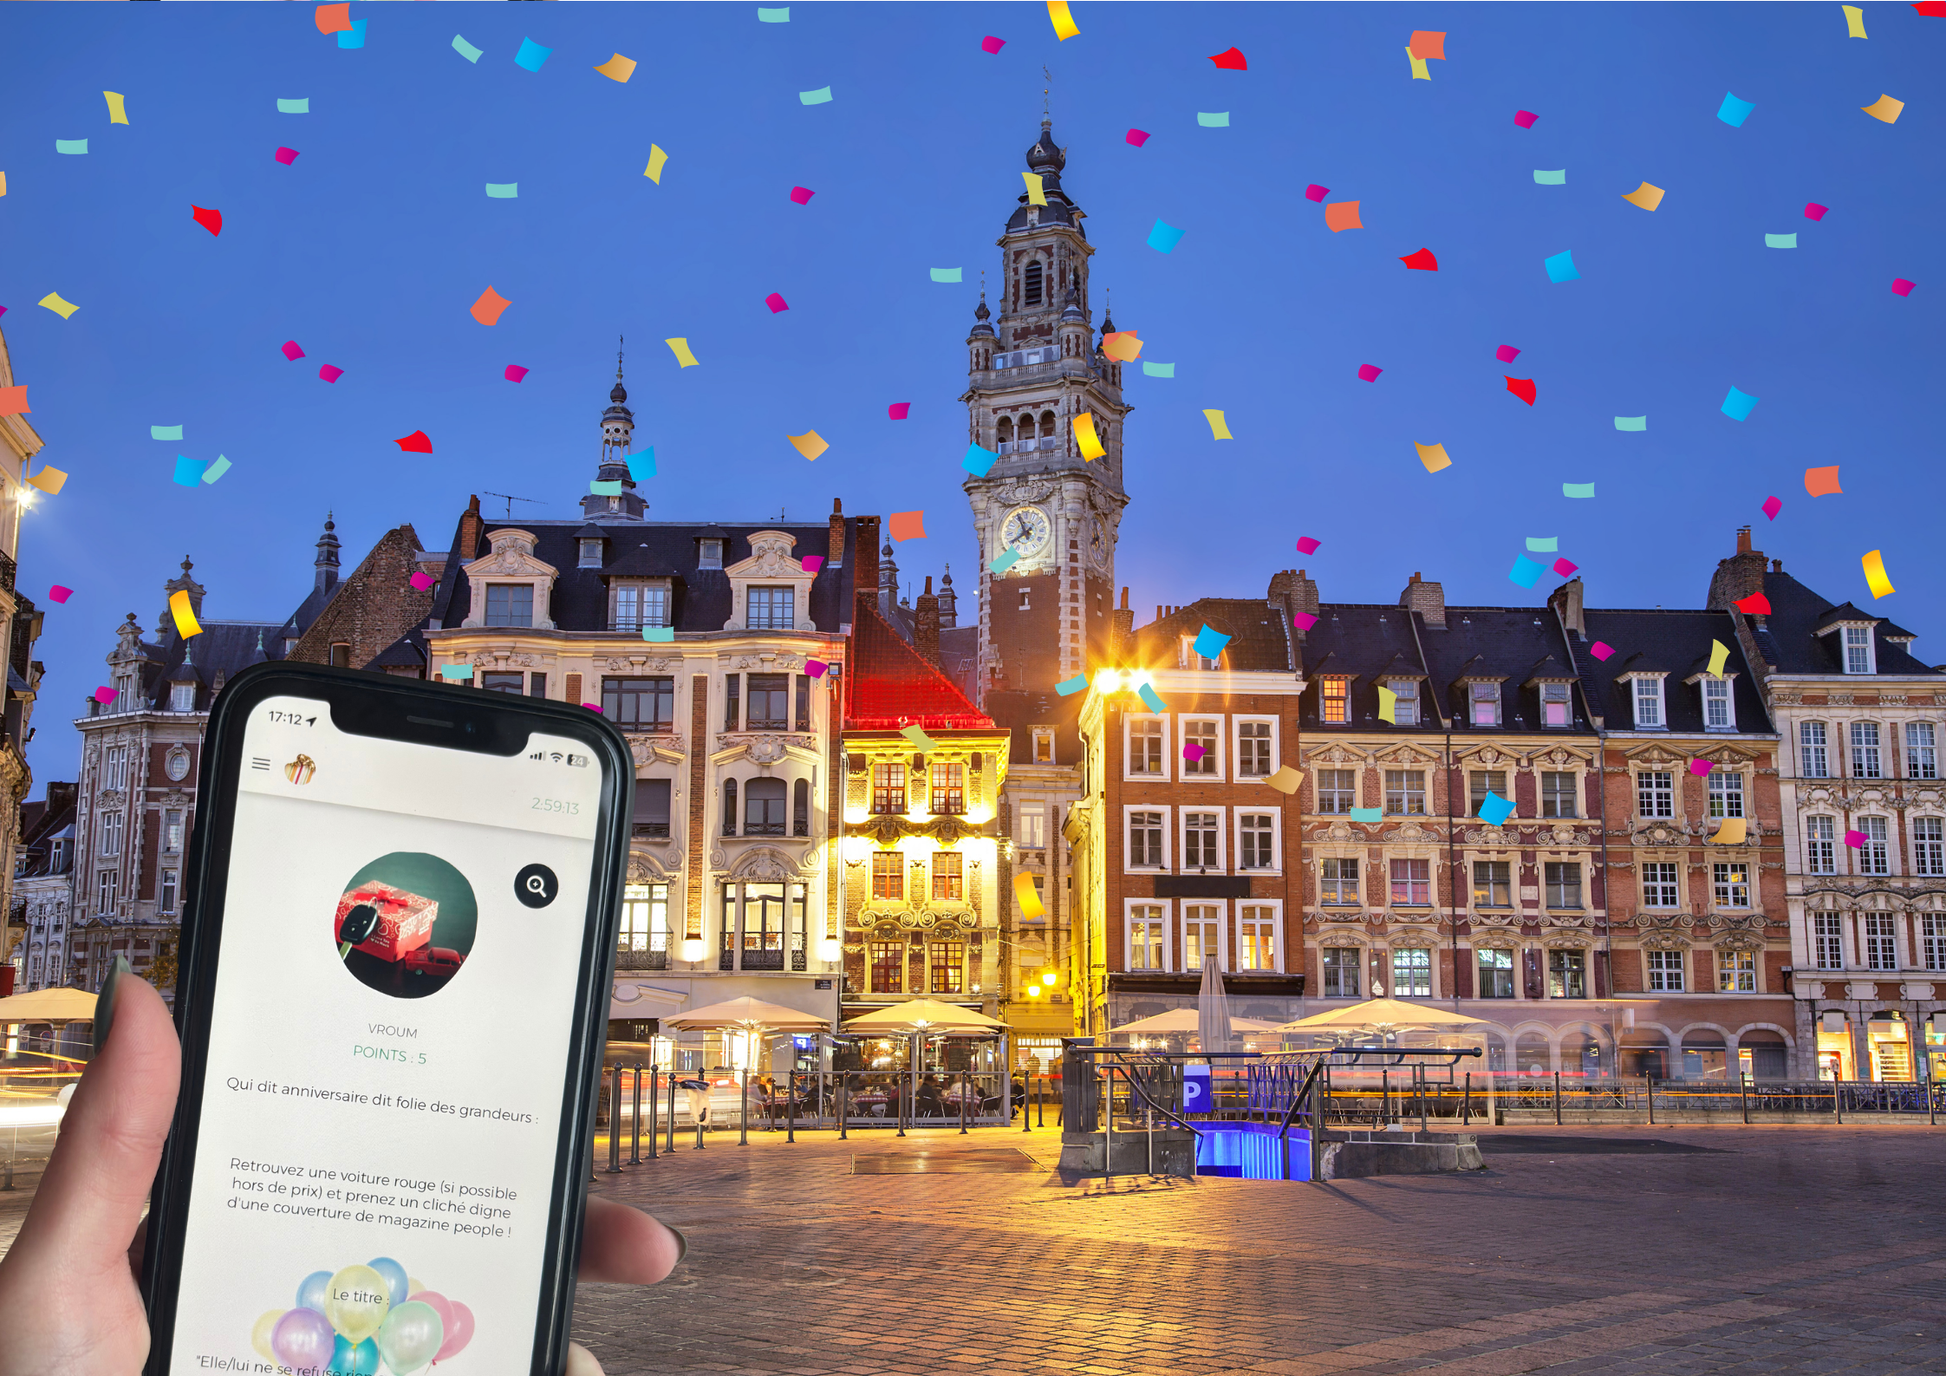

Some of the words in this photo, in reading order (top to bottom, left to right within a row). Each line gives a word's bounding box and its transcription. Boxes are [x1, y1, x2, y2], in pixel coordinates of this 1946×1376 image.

[268, 710, 302, 726] 17:12
[570, 756, 583, 767] 24
[531, 796, 580, 815] 2:59:13
[368, 1022, 418, 1039] VROUM
[353, 1044, 407, 1063] POINTS
[417, 1052, 427, 1065] 5
[226, 1076, 253, 1092] Qui
[257, 1079, 278, 1095] dit
[281, 1085, 369, 1105] anniversaire
[371, 1093, 393, 1108] dit
[396, 1096, 427, 1111] folie
[429, 1101, 456, 1115] des
[459, 1106, 532, 1124] grandeurs
[1183, 1081, 1202, 1107] P
[230, 1157, 304, 1177] Retrouvez
[308, 1168, 337, 1181] une
[340, 1171, 390, 1187] voiture
[393, 1178, 437, 1195] rouge
[440, 1180, 455, 1195] (si
[458, 1185, 518, 1201] possible
[231, 1176, 264, 1193] hors
[267, 1180, 288, 1195] de
[290, 1185, 323, 1202] prix)
[326, 1189, 342, 1201] et
[345, 1191, 396, 1207] prenez
[399, 1197, 419, 1209] un
[422, 1197, 466, 1214] cliché
[469, 1203, 512, 1220] digne
[227, 1195, 270, 1212] d'une
[273, 1203, 351, 1221] couverture
[354, 1209, 375, 1223] de
[377, 1214, 450, 1232] magazine
[453, 1222, 504, 1238] people
[507, 1226, 511, 1238] !
[333, 1287, 350, 1301] Le
[353, 1290, 383, 1304] titre
[196, 1354, 250, 1371] "Elle/lui
[254, 1363, 273, 1374] ne
[277, 1365, 292, 1376] se
[296, 1365, 342, 1376] refuse
